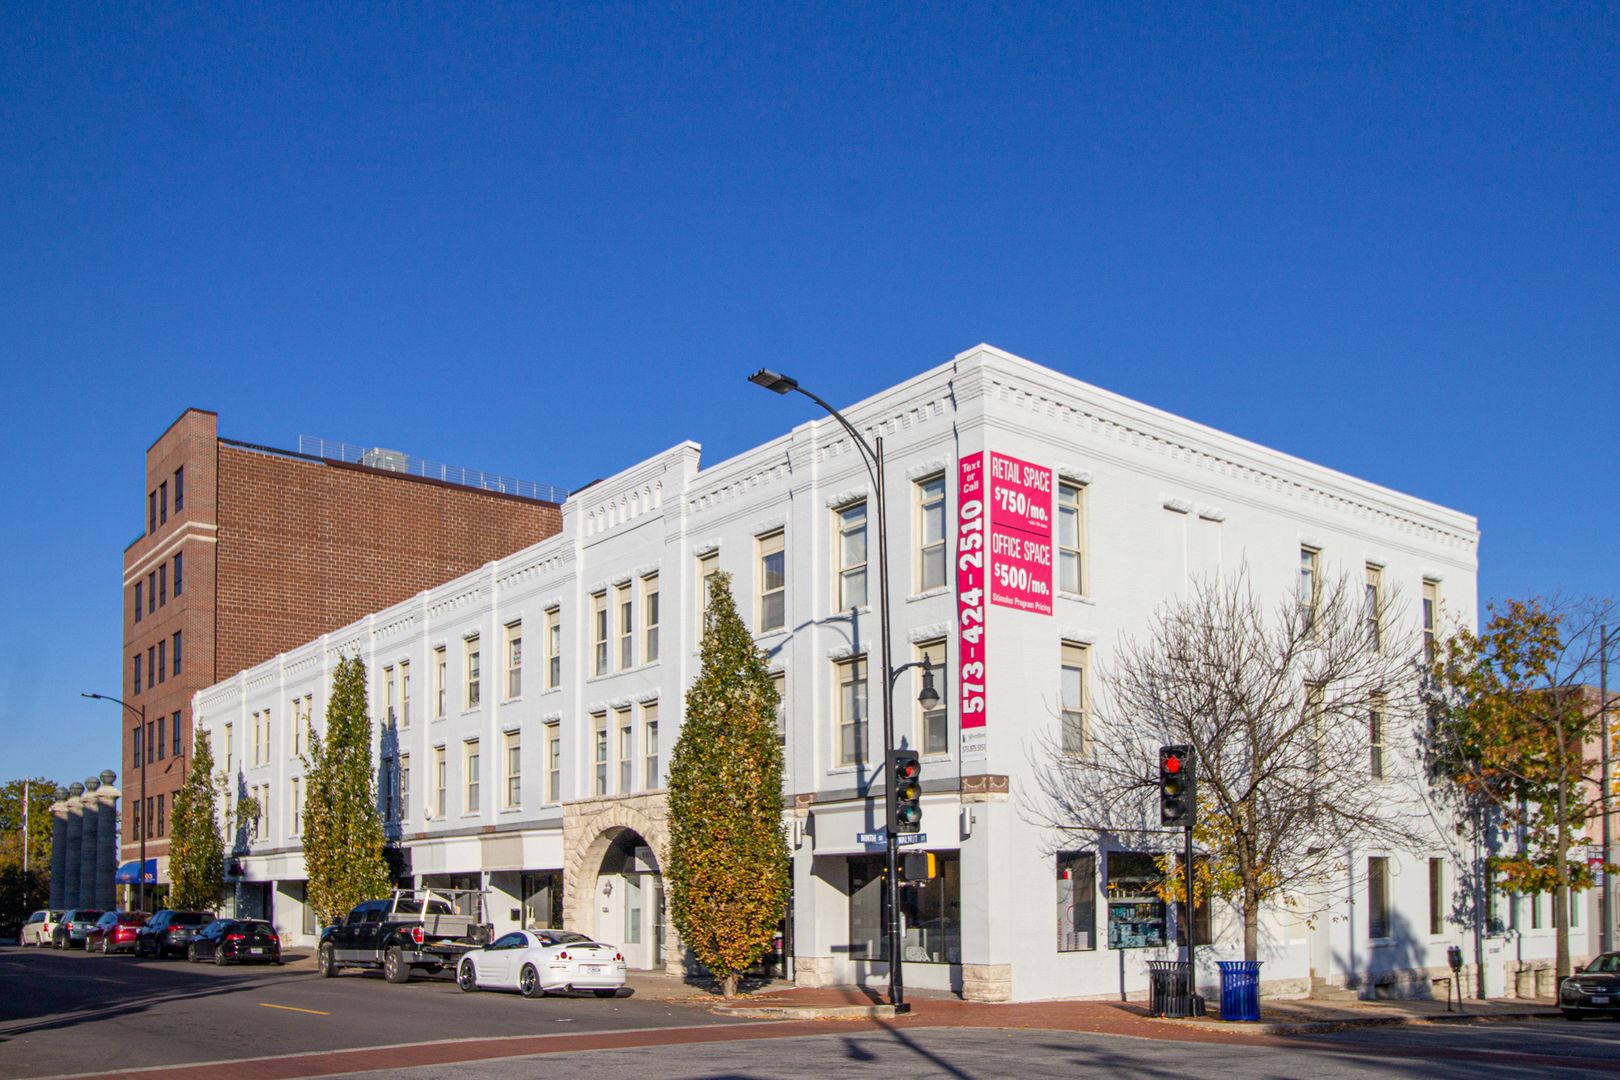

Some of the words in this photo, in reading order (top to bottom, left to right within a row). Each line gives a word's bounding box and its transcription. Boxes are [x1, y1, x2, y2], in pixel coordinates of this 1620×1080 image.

[962, 460, 981, 473] Text
[966, 473, 975, 482] or
[992, 456, 1021, 485] RETAIL
[1023, 466, 1050, 493] SPACE
[963, 480, 979, 494] Call
[994, 485, 1048, 522] $750/mo.
[992, 532, 1021, 559] OFFICE
[1023, 540, 1051, 566] SPACE
[994, 561, 1050, 596] $500/mo.
[959, 499, 985, 714] 573-424-2510
[992, 592, 1014, 605] Stimulus
[1014, 597, 1035, 609] Program
[1035, 601, 1051, 614] Pricing
